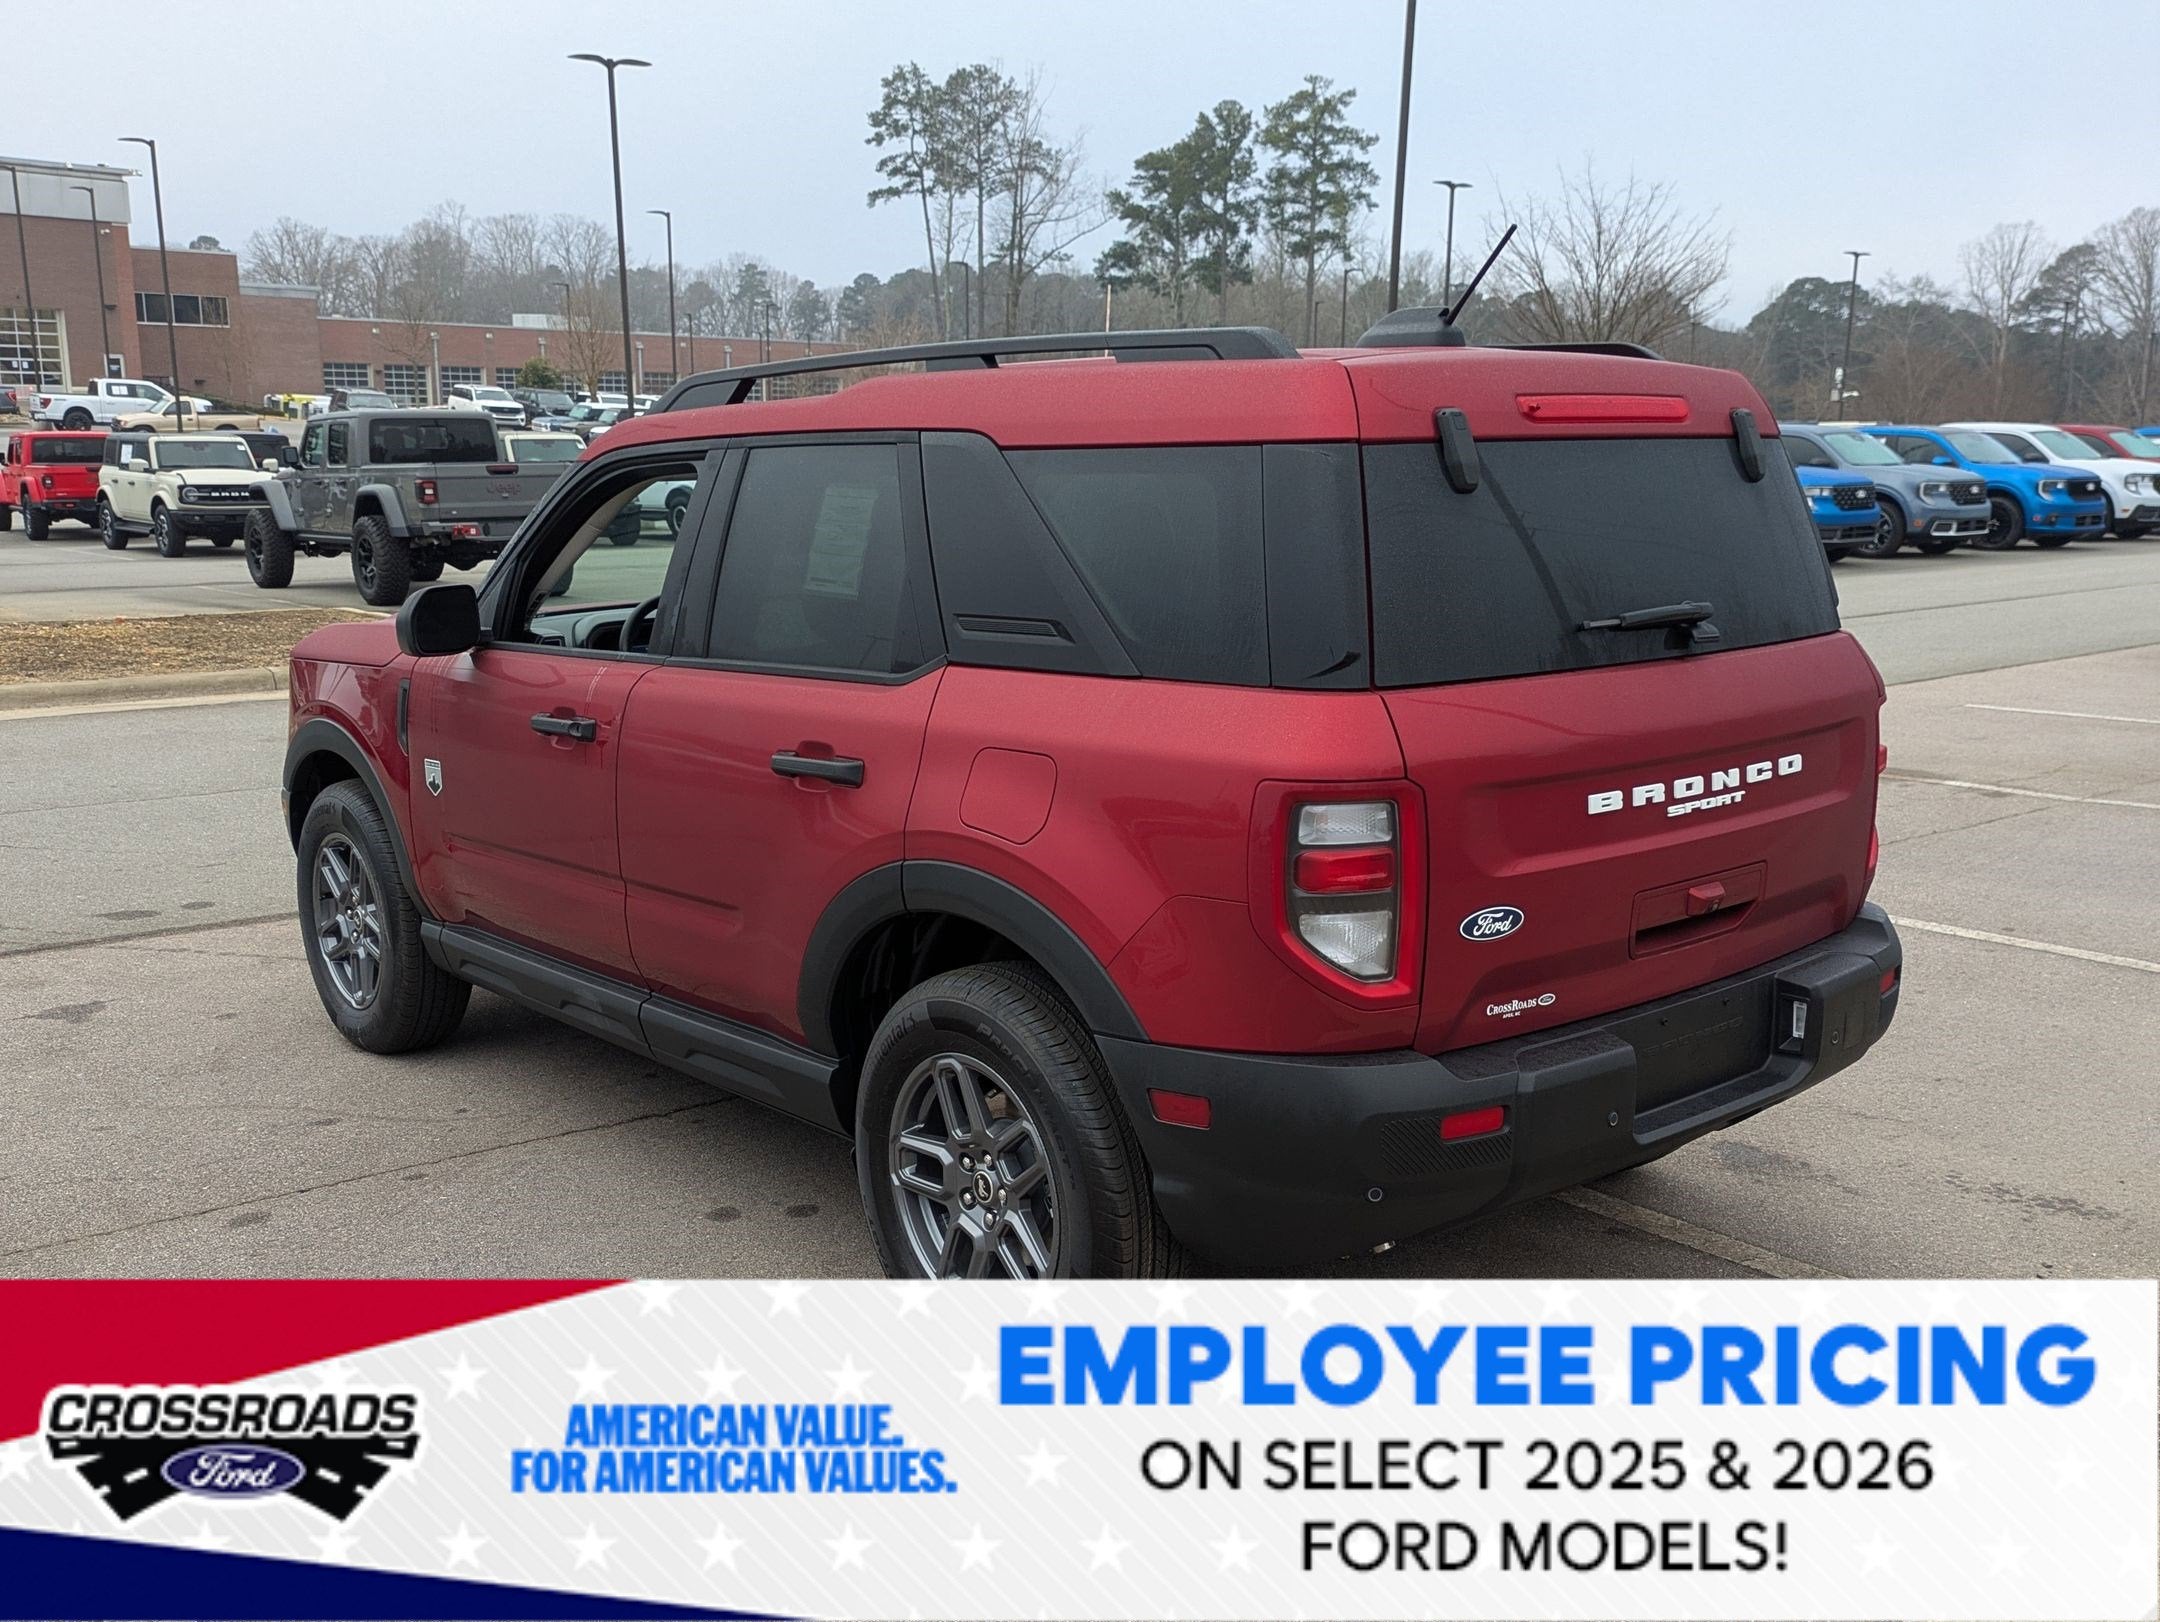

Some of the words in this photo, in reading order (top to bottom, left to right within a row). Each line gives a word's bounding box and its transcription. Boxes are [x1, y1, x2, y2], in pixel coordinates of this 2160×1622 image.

[1587, 753, 1803, 815] BRONCO
[1667, 790, 1746, 818] SPORT
[1473, 911, 1514, 937] Ford
